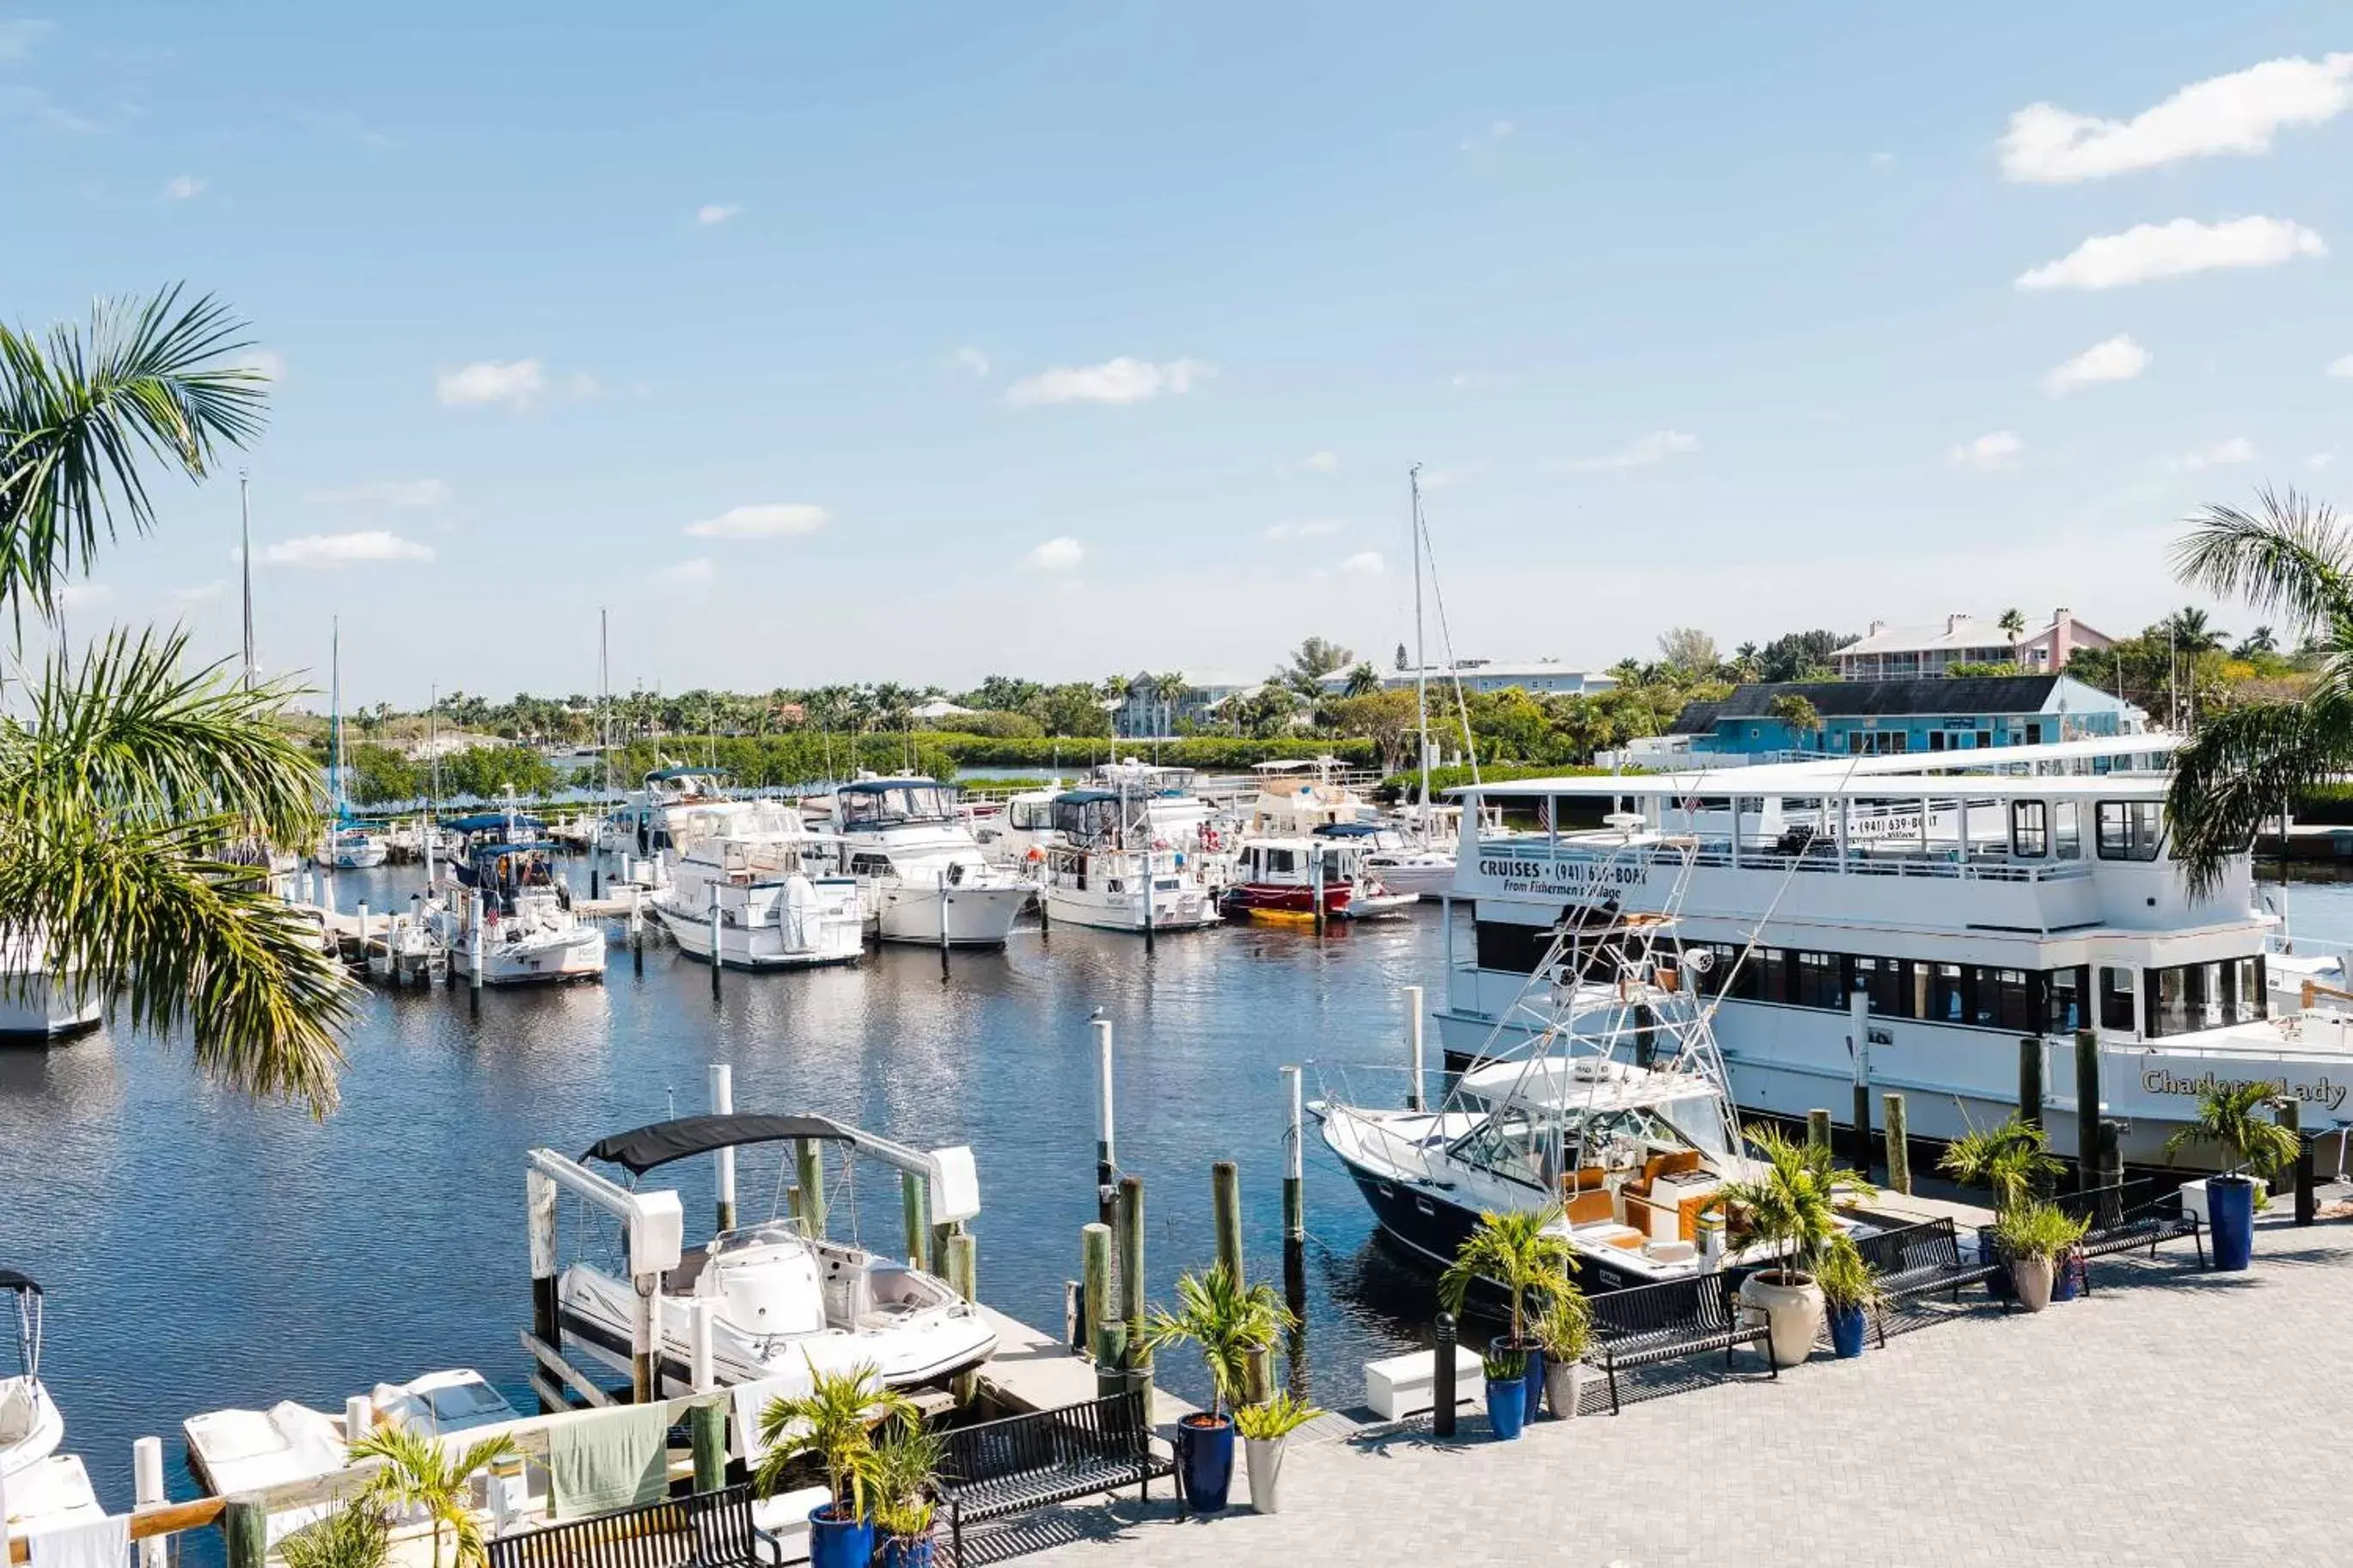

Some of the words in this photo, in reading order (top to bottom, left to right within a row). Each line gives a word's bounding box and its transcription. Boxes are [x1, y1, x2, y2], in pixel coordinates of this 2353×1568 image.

[1890, 815, 1938, 831] 639-BT
[1479, 860, 1540, 877] CRUISES
[1555, 862, 1585, 883] (941)
[1588, 865, 1647, 886] 69-BOAT
[1504, 879, 1527, 892] From
[1587, 884, 1622, 900] Vlage
